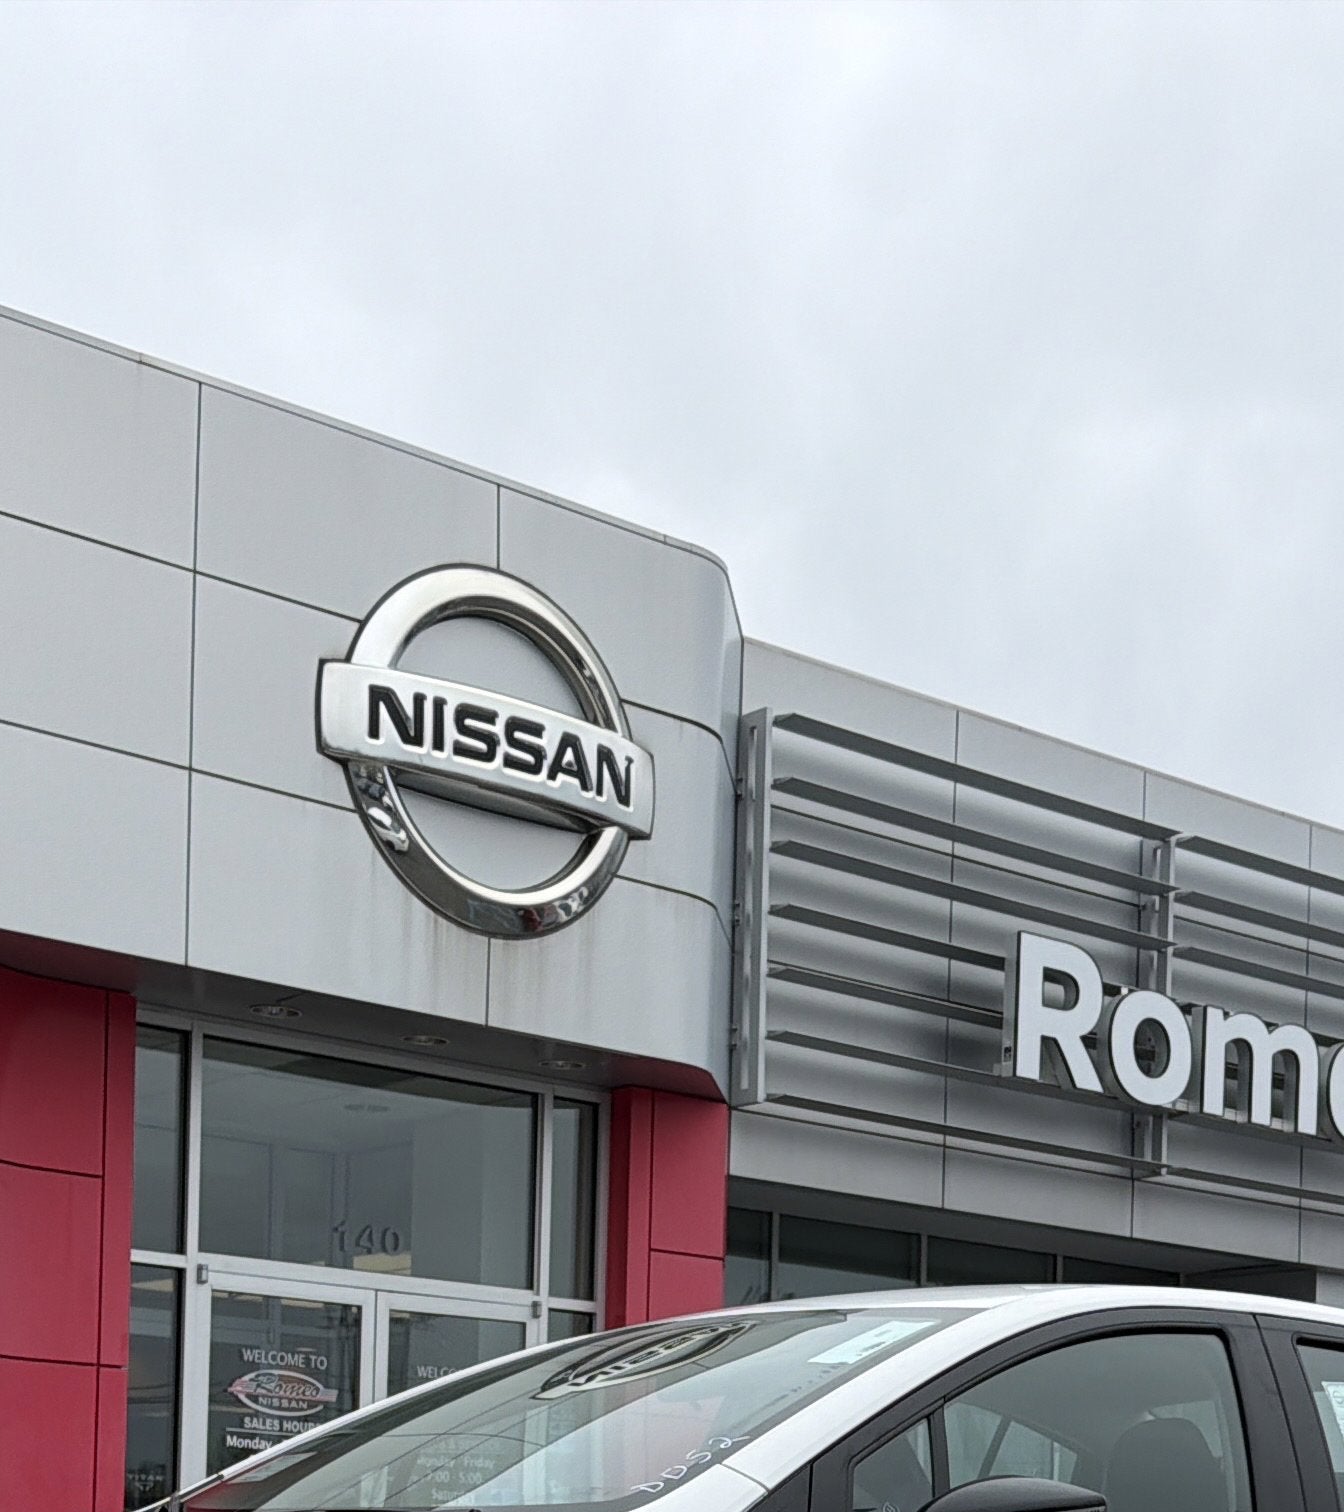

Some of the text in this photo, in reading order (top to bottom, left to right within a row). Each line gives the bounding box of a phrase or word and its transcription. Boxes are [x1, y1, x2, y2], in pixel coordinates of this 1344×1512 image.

[367, 684, 633, 812] NISSAN
[333, 1220, 400, 1254] 140
[242, 1347, 328, 1370] WELCOME TO
[417, 1365, 457, 1378] WELC
[255, 1374, 320, 1398] Romeo
[258, 1397, 308, 1409] NISSAN
[244, 1416, 279, 1431] SALES
[226, 1434, 273, 1450] Monday
